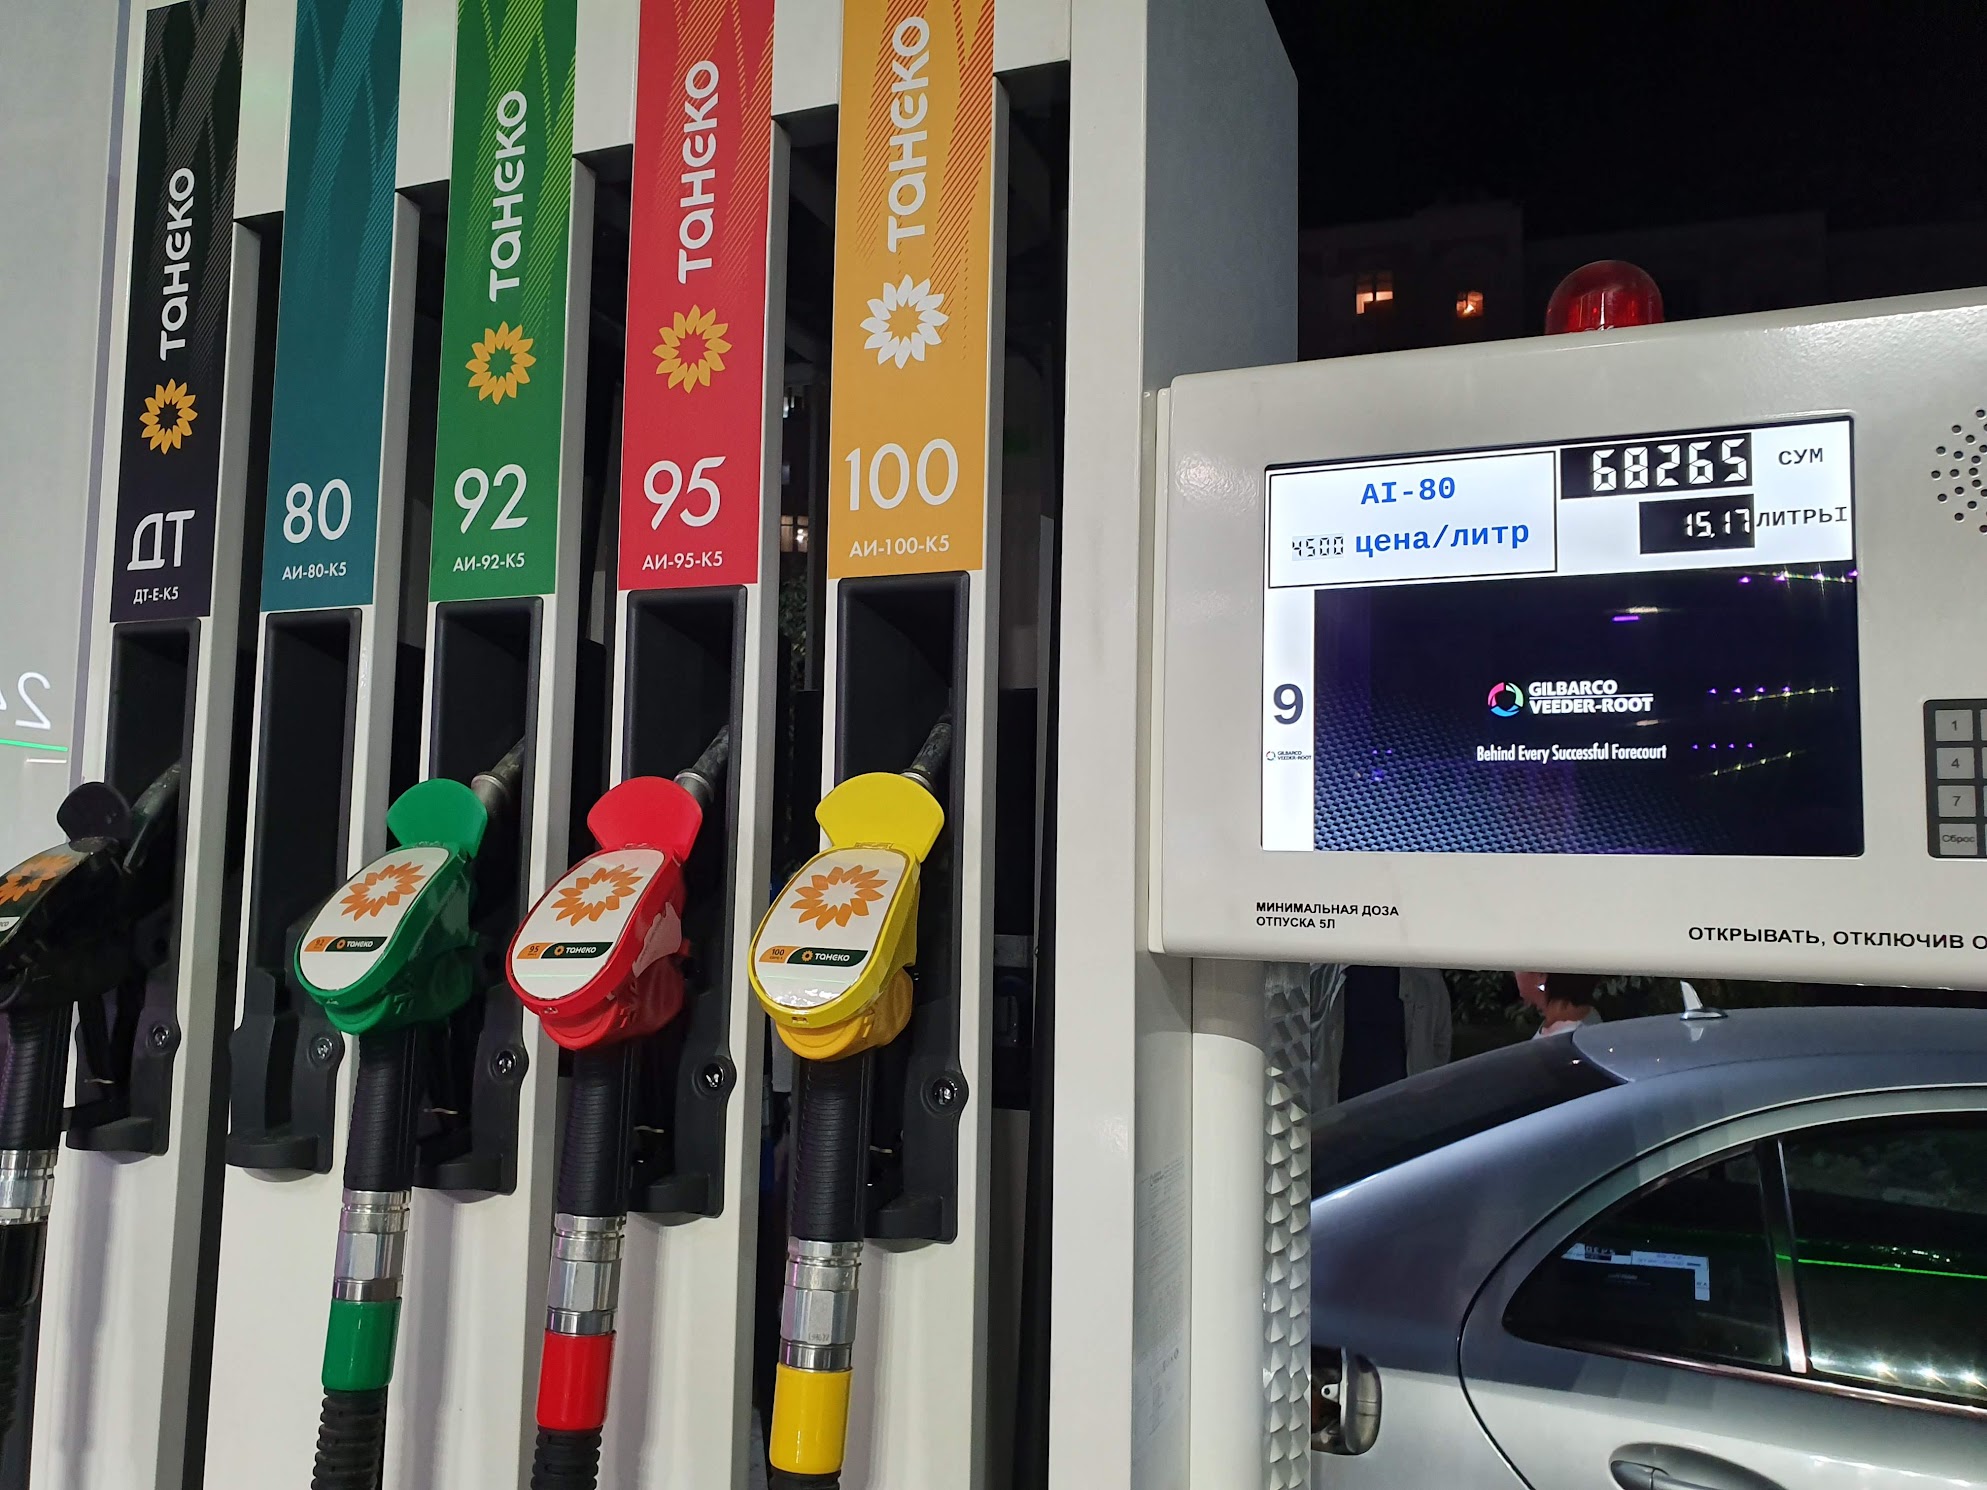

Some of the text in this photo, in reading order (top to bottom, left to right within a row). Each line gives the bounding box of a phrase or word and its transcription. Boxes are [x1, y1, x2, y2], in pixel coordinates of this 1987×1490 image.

[1592, 438, 1747, 492] 68265
[1778, 448, 1824, 466] СУМ
[844, 438, 959, 511] 100
[454, 464, 529, 534] 92
[643, 456, 726, 531] 95
[1360, 477, 1456, 505] AI-80
[283, 478, 352, 544] 80
[1756, 506, 1848, 527] ЛИТРЫ
[127, 510, 195, 571] ДТ
[849, 535, 950, 557] АИ-100-К5
[1292, 523, 1529, 558] 4500 цена/литр
[452, 553, 525, 573] АИ-92-К5
[641, 550, 723, 571] АИ-95-К5
[282, 562, 347, 582] АИ-80-К5
[133, 586, 179, 605] ДТ-Е-К5
[1529, 679, 1618, 697] GILBARCO
[1273, 683, 1304, 725] 9
[1529, 697, 1653, 714] VEEDER-ROOT
[1951, 720, 1958, 731] 1
[1477, 743, 1667, 764] Behind Every Successful Forecourt
[1951, 758, 1960, 768] 4
[1952, 796, 1961, 806] 7
[1942, 834, 1975, 843] Сброс
[1256, 902, 1399, 917] МИНИМАЛЬНАЯ ДОЗА
[1256, 916, 1335, 928] ОТПУСКА 5Л
[1689, 926, 1826, 947] ОТКРЫВАТЬ,
[1832, 931, 1965, 949] ОТКЛЮЧИВ
[528, 945, 540, 953] 95
[771, 948, 785, 956] 100
